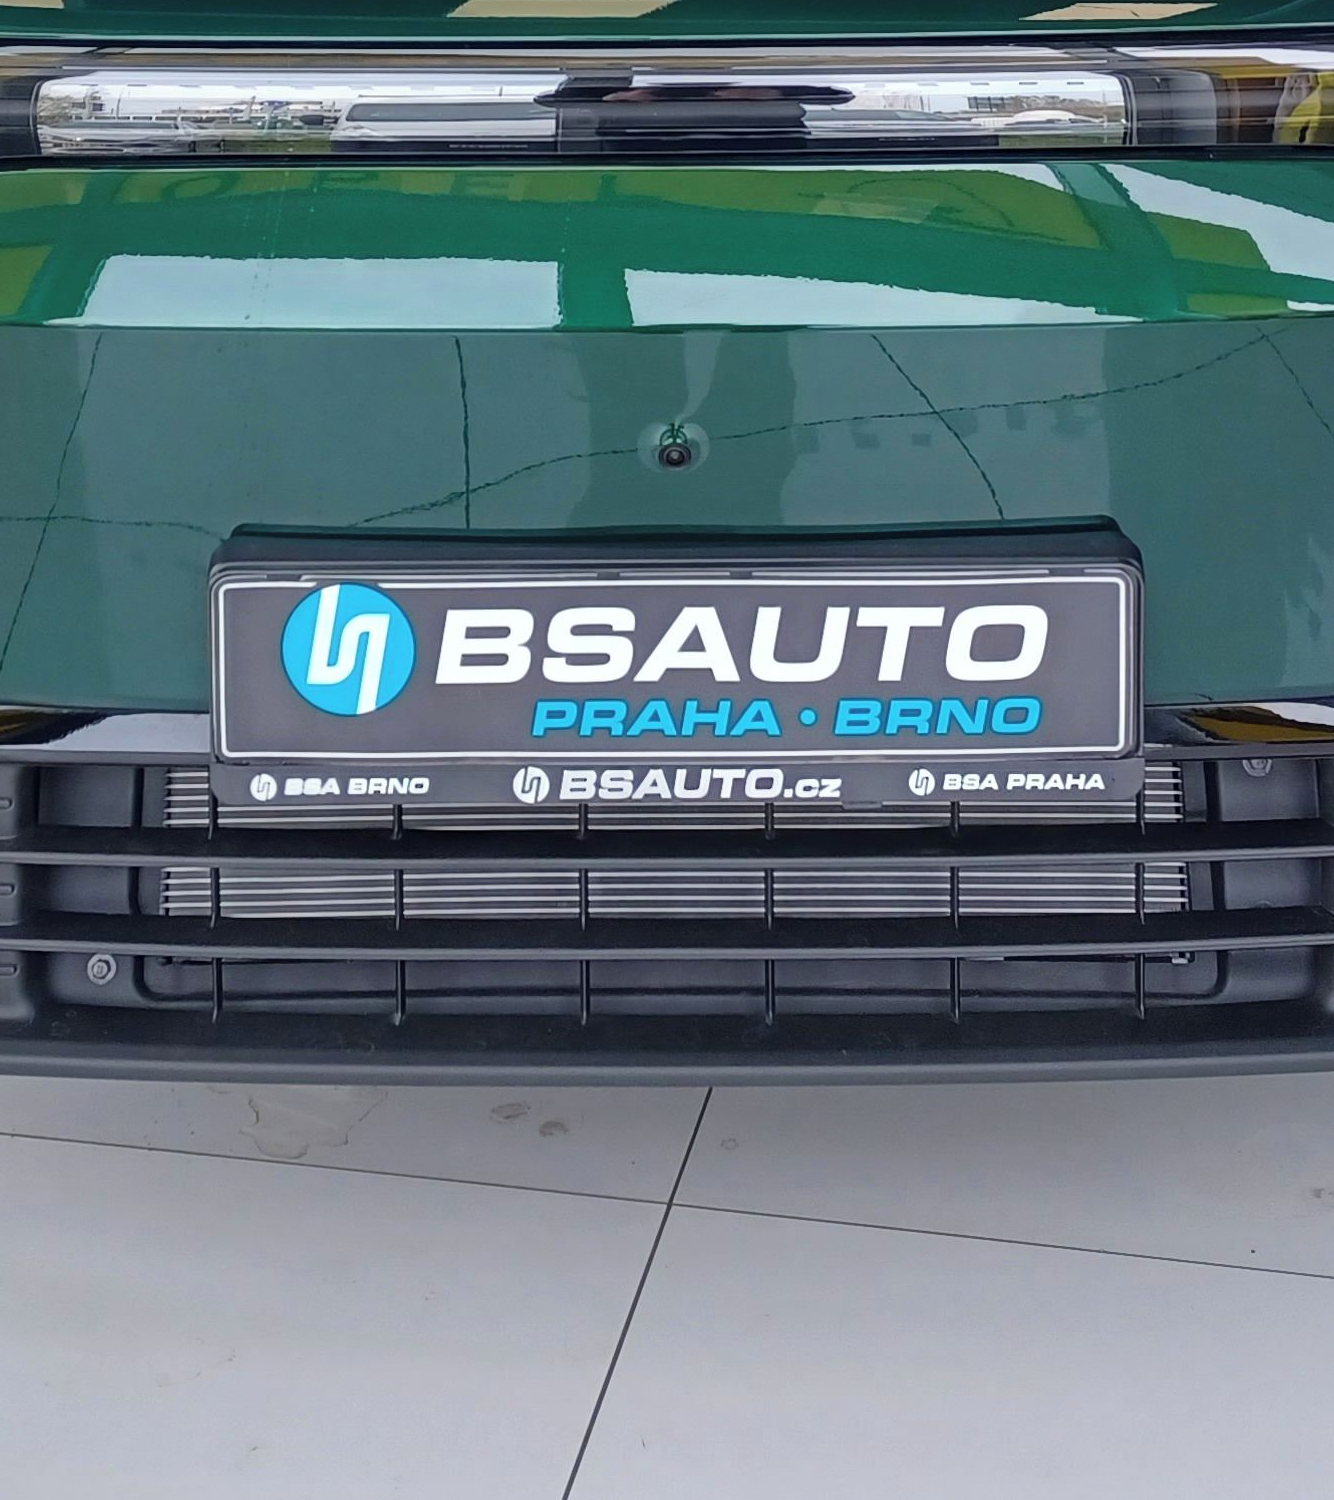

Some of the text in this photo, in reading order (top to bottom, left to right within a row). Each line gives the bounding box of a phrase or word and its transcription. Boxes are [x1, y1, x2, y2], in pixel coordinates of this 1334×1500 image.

[435, 604, 1048, 685] BSAUTO
[531, 697, 1042, 737] PRAHA BRNO
[347, 777, 430, 795] BRNO
[559, 768, 843, 800] BSAUTO.cz
[942, 773, 1106, 790] BSA PRAHA
